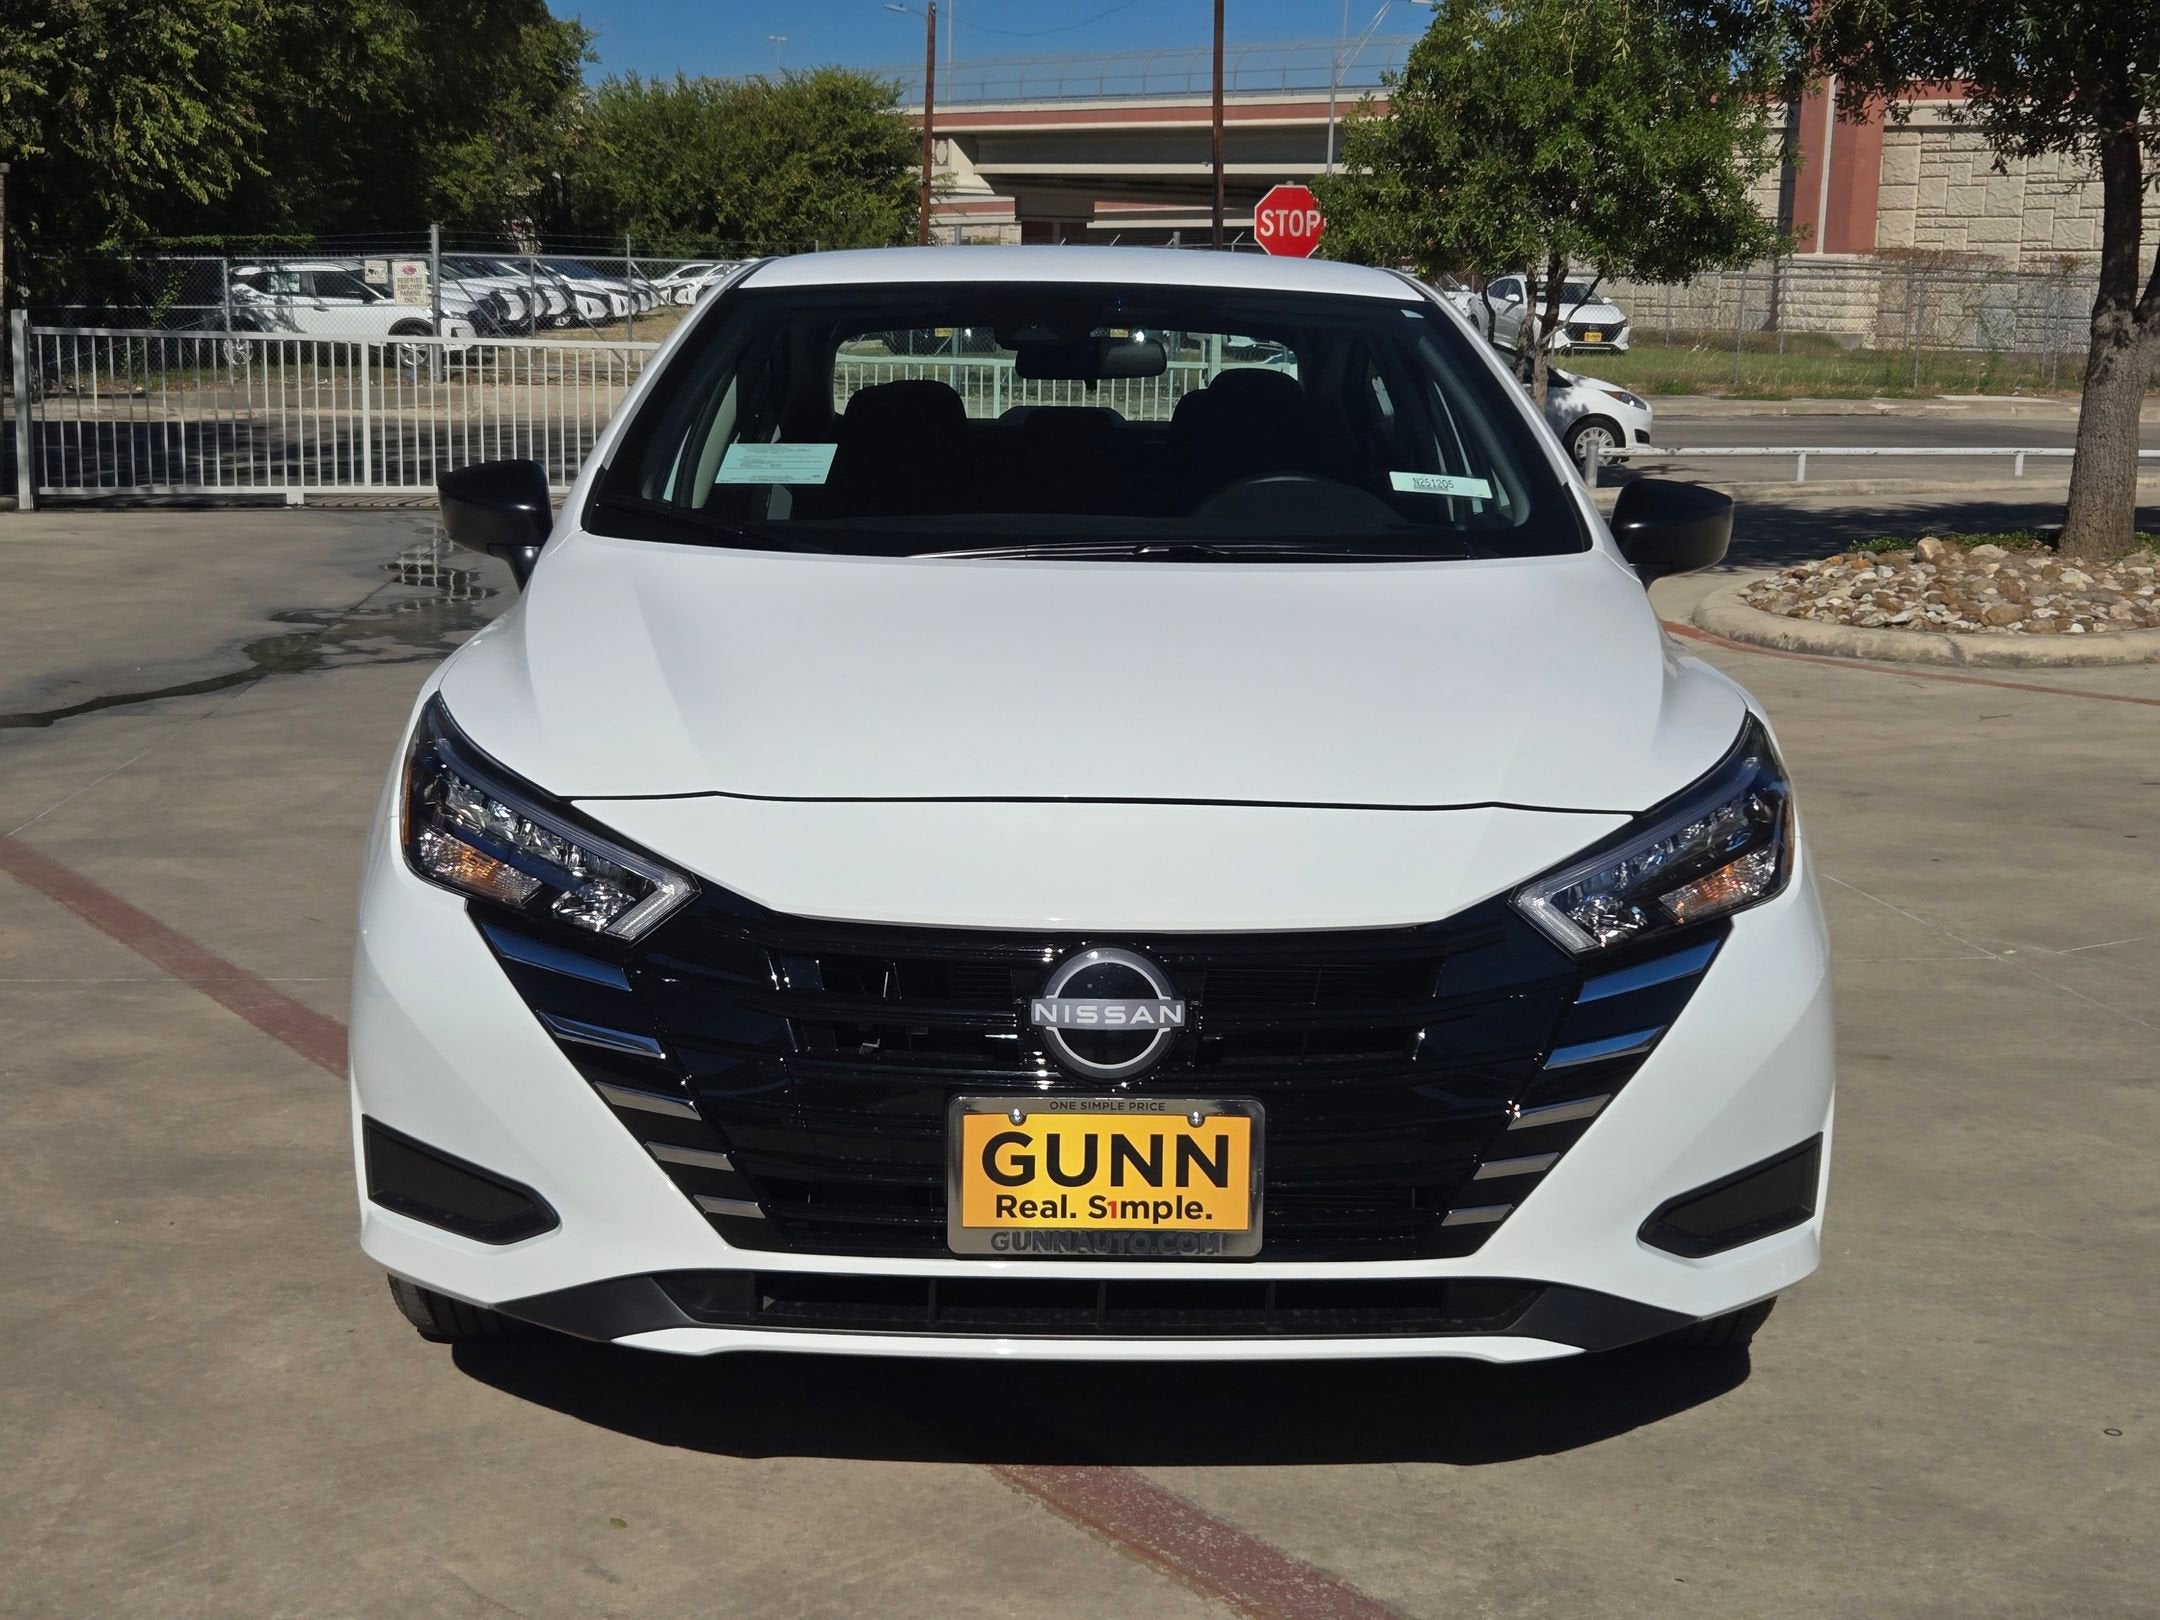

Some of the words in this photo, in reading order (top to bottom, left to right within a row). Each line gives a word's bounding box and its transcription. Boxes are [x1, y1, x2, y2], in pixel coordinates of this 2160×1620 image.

[1260, 209, 1321, 237] STOP
[1035, 1003, 1181, 1024] NISSAN
[1049, 1101, 1076, 1110] ONE
[1080, 1101, 1125, 1110] SIMPLE
[1129, 1102, 1165, 1111] PRICE
[982, 1131, 1229, 1188] GUNN
[996, 1194, 1076, 1219] Real.
[990, 1231, 1222, 1255] GUNNAUTO.COM
